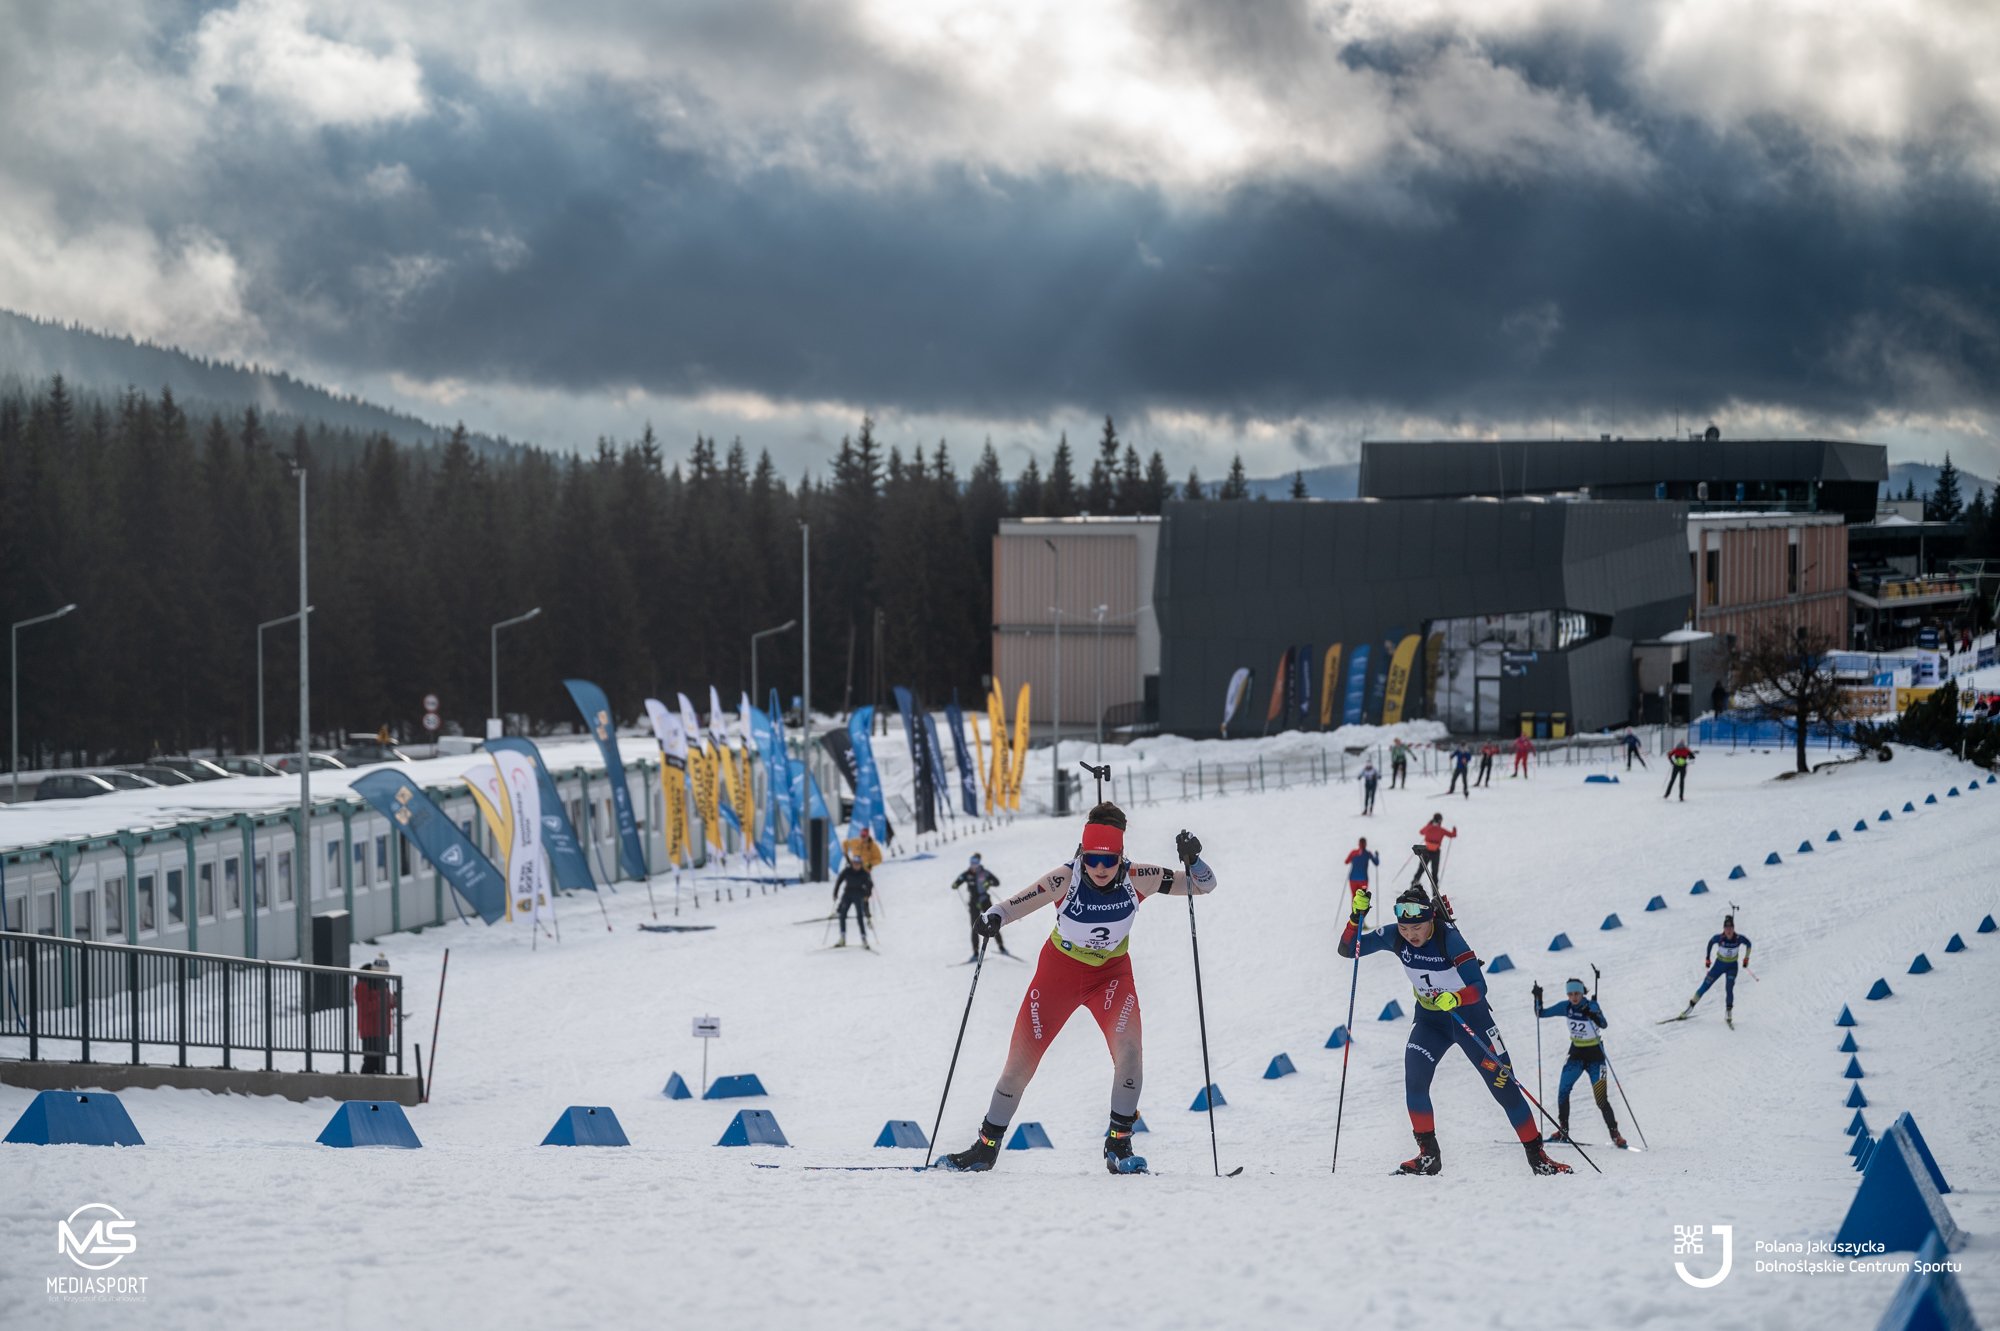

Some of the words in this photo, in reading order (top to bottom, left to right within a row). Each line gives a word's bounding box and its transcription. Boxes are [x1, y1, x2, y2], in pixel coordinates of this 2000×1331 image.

[1138, 867, 1160, 876] BKW
[1010, 890, 1037, 906] helvetia
[1065, 885, 1077, 901] JOKA
[1124, 883, 1136, 898] JOKA
[1089, 926, 1111, 942] 3
[1104, 979, 1119, 1010] odlo
[1030, 1001, 1043, 1039] Sunrise
[1116, 992, 1136, 1033] RAIFFEISEN
[1570, 1021, 1587, 1033] 22
[1496, 1034, 1506, 1051] 1
